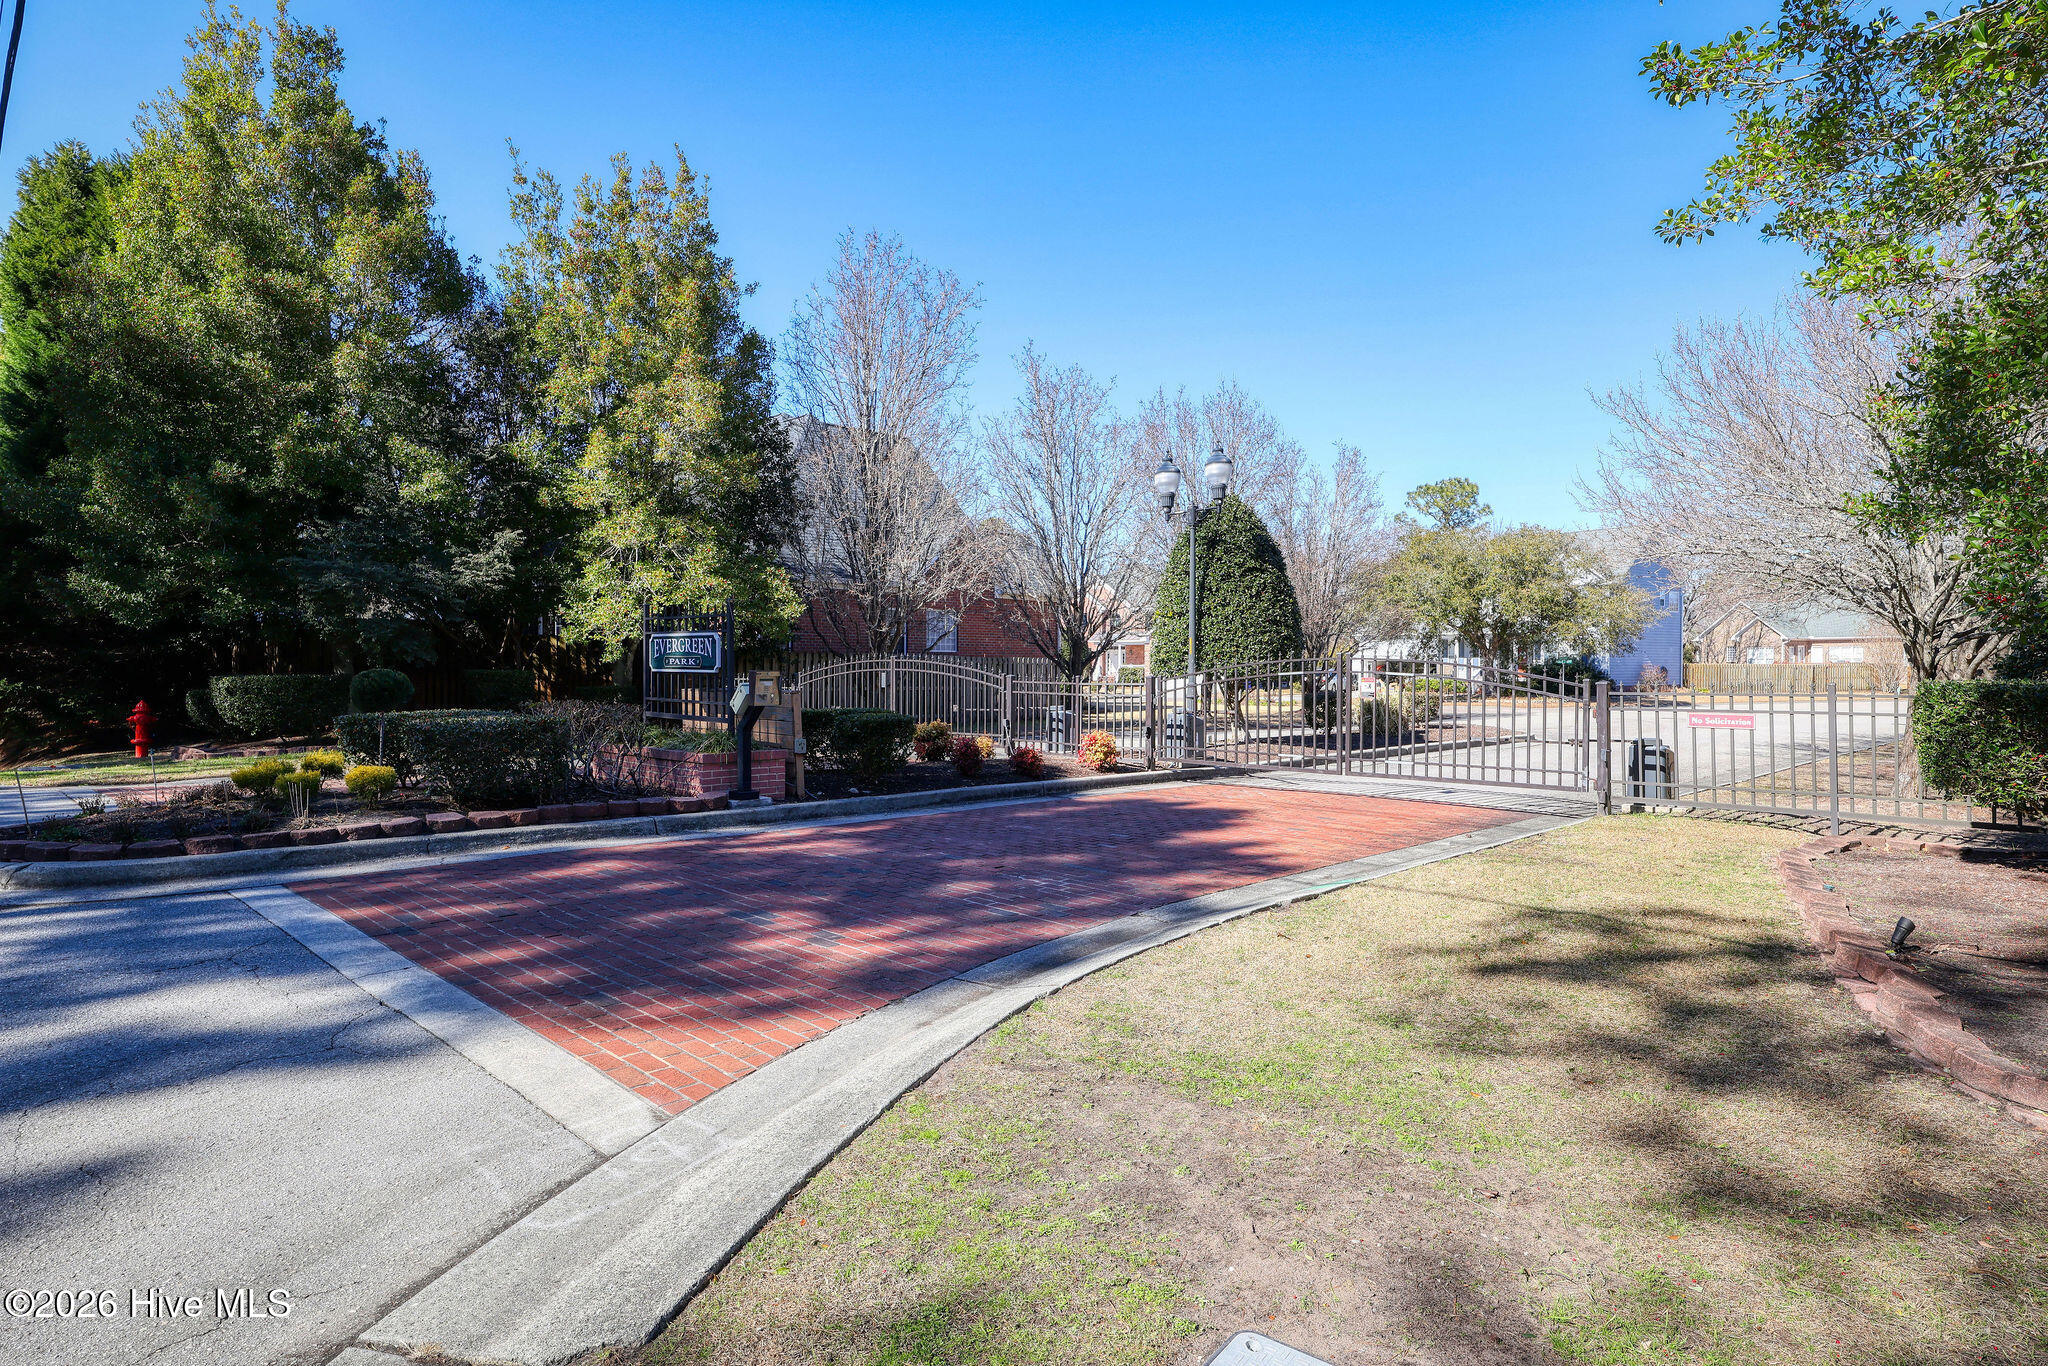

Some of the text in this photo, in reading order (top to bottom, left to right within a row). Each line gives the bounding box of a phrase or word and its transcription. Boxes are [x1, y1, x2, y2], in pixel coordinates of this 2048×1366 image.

[653, 638, 713, 658] EVERGREEN
[669, 658, 696, 666] PARK
[1705, 717, 1752, 726] Solicitation
